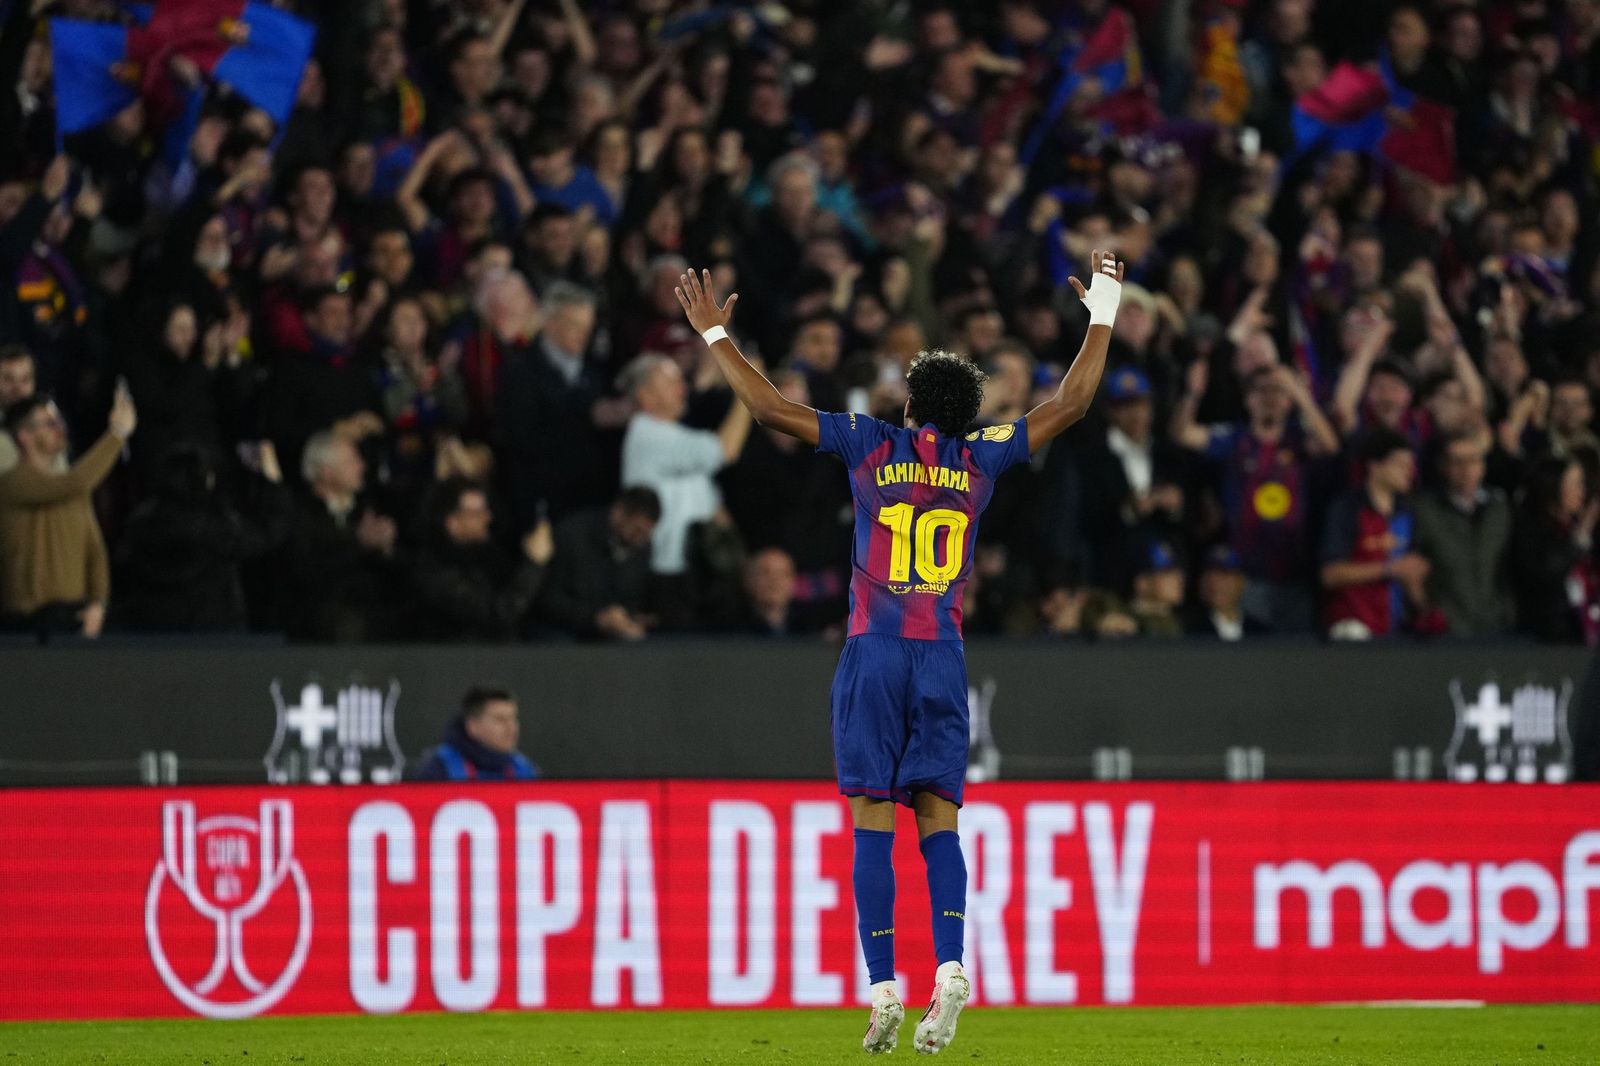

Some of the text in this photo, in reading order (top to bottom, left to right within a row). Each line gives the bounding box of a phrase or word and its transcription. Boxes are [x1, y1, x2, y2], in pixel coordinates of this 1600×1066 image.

[876, 462, 928, 487] LAMIN
[878, 502, 969, 583] 10
[914, 583, 949, 593] ACNUR
[348, 800, 663, 1011] COPA
[957, 802, 1154, 1006] REY
[1253, 830, 1600, 973] mapf
[943, 910, 966, 920] BARC
[871, 928, 895, 937] BARC
